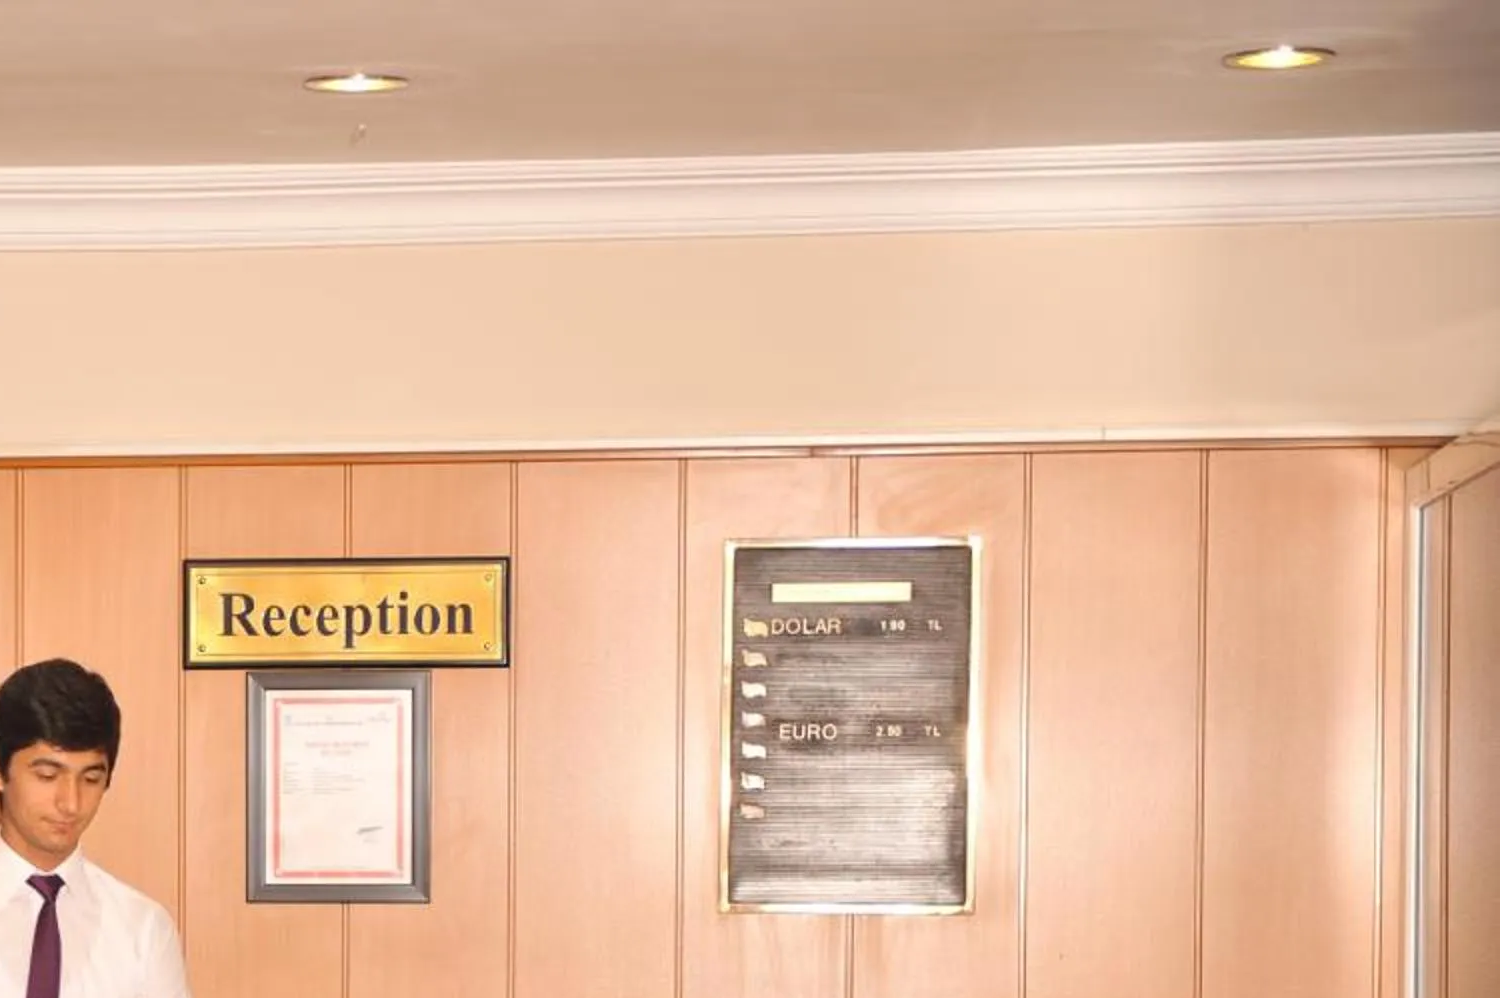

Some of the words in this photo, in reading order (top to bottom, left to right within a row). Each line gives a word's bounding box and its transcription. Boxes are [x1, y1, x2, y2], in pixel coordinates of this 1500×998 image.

[218, 589, 474, 649] Reception
[771, 618, 841, 635] DOLAR
[928, 620, 942, 630] TL
[779, 724, 837, 740] EURO
[924, 726, 940, 737] TL
